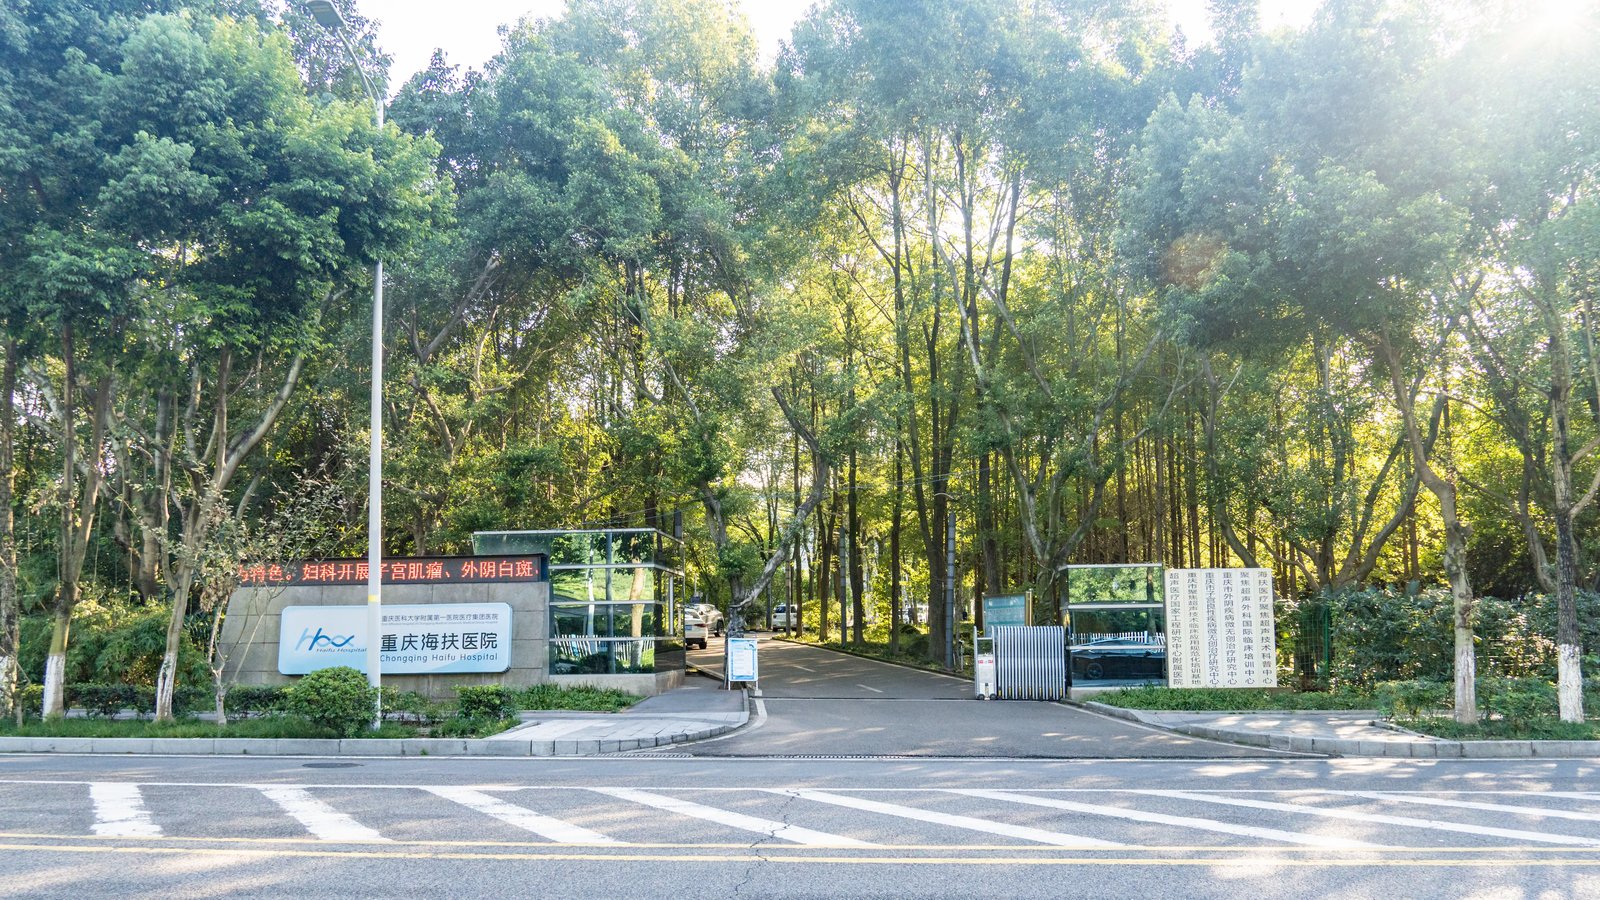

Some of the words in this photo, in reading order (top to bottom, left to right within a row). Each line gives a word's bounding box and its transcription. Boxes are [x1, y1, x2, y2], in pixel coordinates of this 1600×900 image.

[380, 632, 498, 652] 重庆海扶医院
[380, 654, 428, 664] Chongqing
[432, 653, 456, 662] Haifu
[460, 653, 498, 661] Hospital
[1169, 572, 1184, 686] 超声医疗国家工程研究中心附属医院
[1223, 571, 1238, 685] 重庆市外阴疾病微无创治疗研究中心
[1240, 571, 1255, 685] 聚焦超声外科国际临床培训中心
[1258, 570, 1273, 685] 海扶医疗聚焦超声技术科普中心
